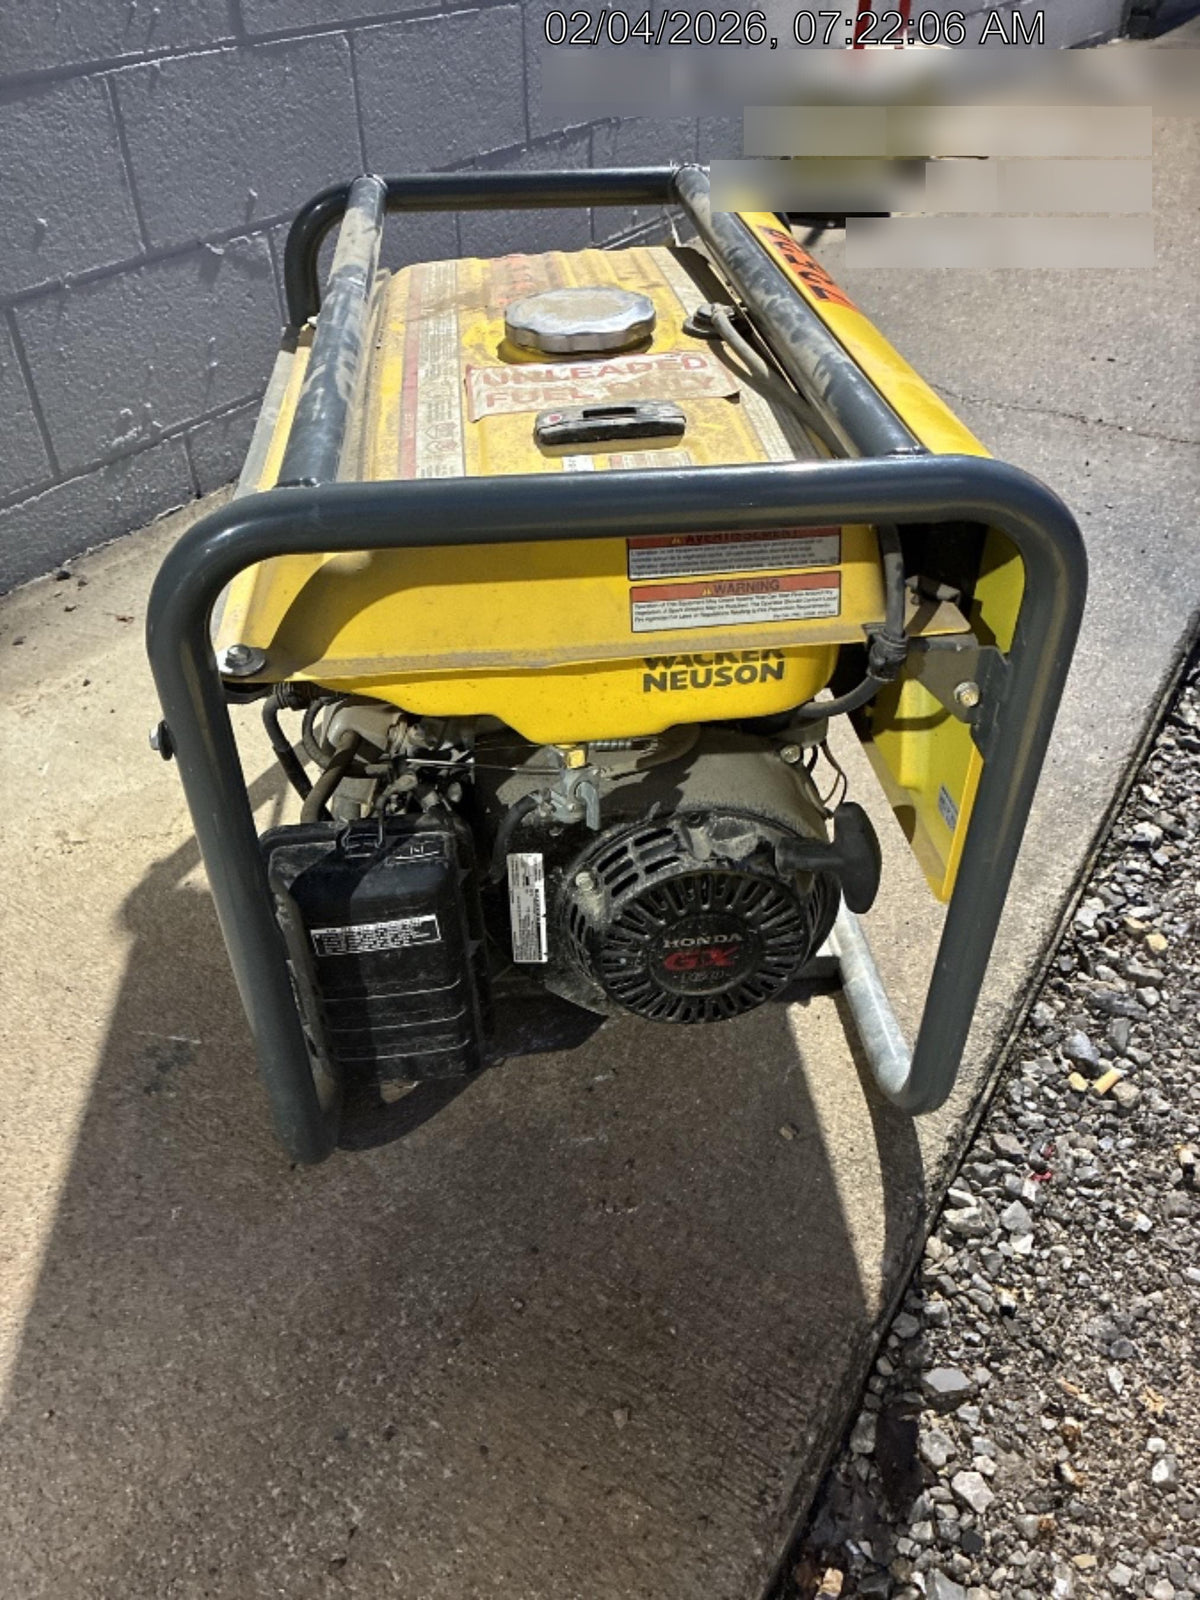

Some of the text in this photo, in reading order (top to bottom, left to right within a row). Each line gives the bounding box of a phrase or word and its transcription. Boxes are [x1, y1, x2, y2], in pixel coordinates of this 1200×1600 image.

[482, 354, 709, 386] UNLEADED
[485, 385, 595, 408] FUEL
[714, 579, 781, 594] WARNING
[643, 648, 786, 670] WACKER
[643, 660, 786, 693] NEUSON
[663, 932, 743, 949] HONDA
[662, 945, 741, 971] GX
